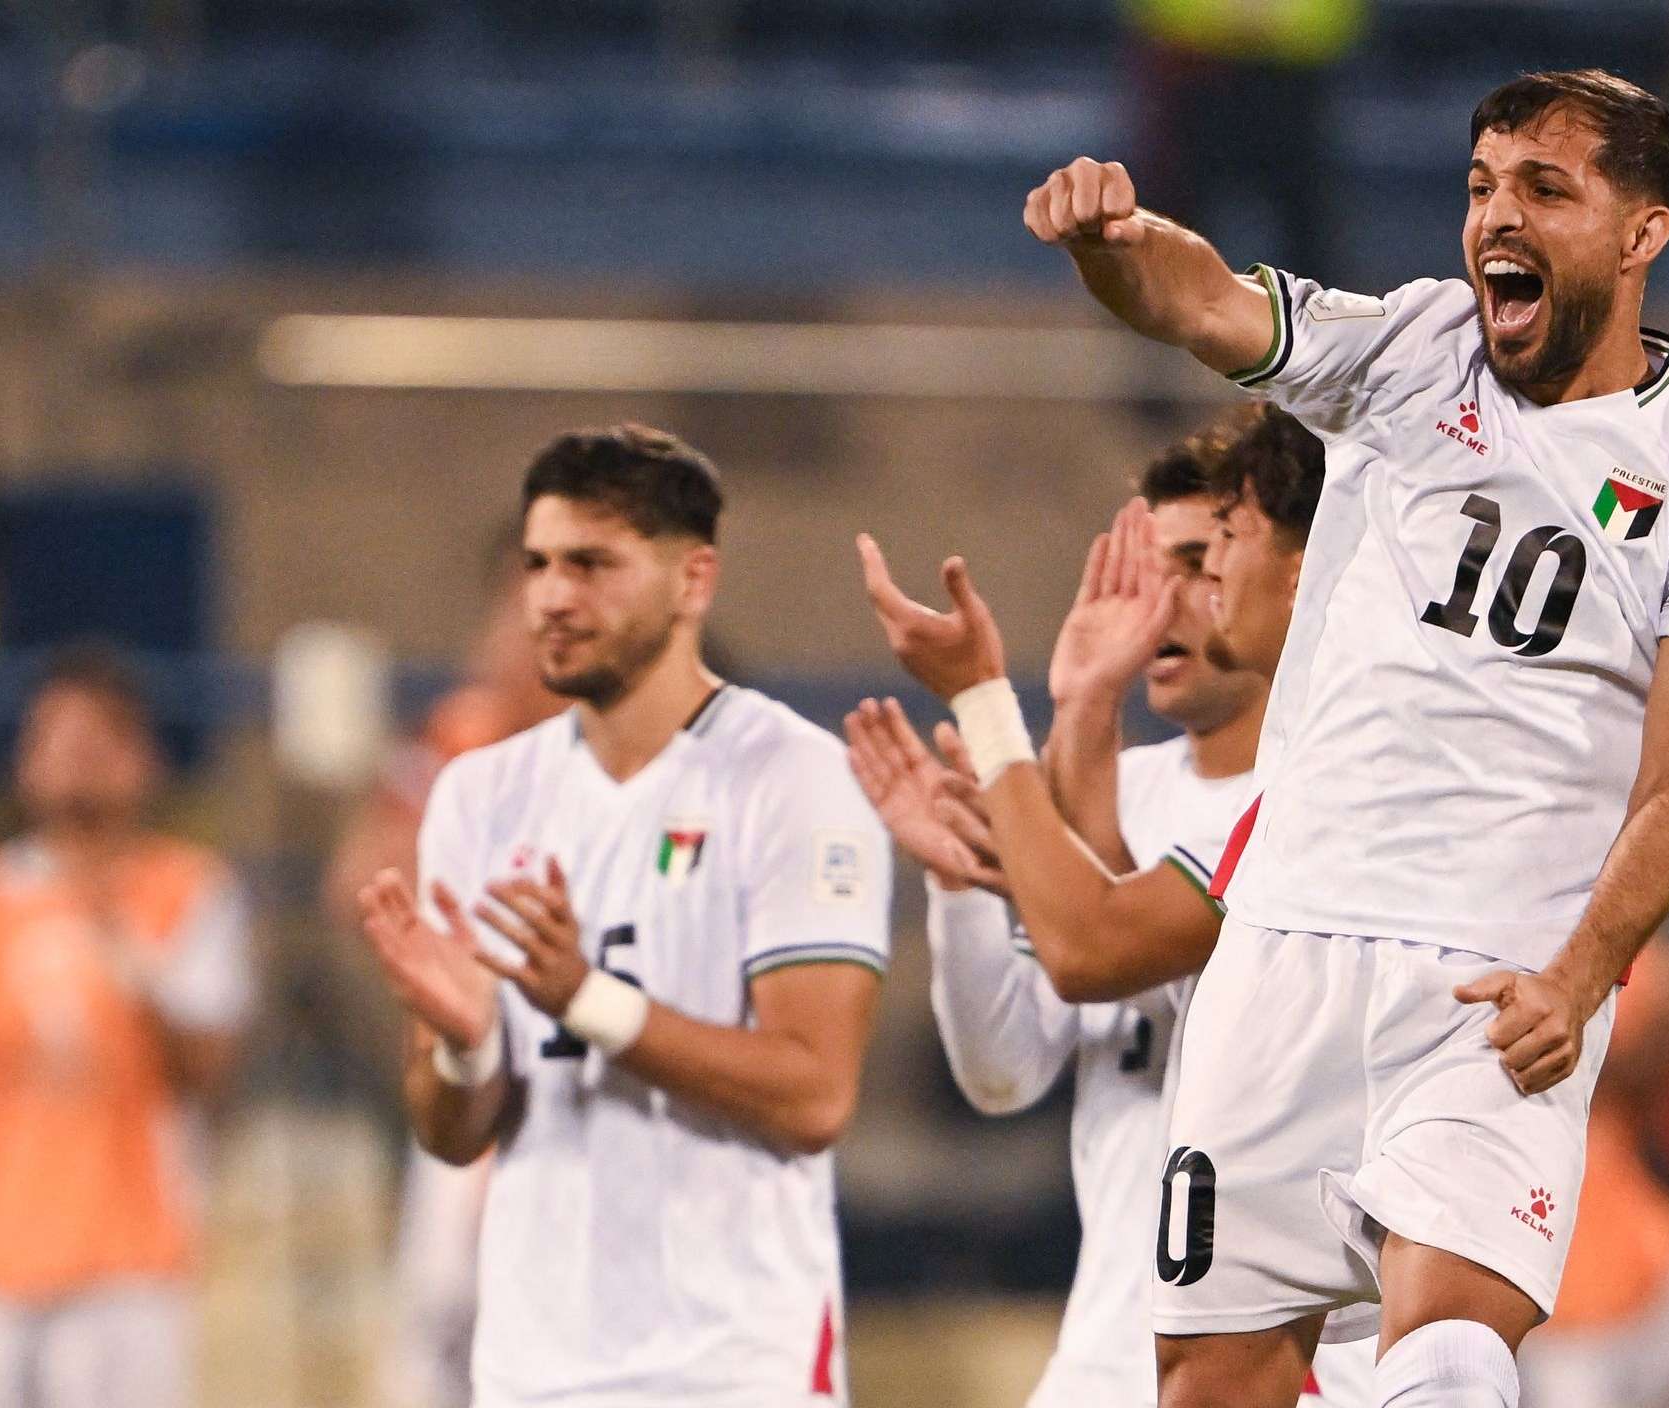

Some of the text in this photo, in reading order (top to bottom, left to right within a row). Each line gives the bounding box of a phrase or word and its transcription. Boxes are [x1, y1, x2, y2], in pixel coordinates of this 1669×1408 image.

[1436, 420, 1489, 456] KELME
[1612, 466, 1668, 494] PALESTINE
[1420, 493, 1587, 657] 10
[1511, 1206, 1554, 1242] KELME
